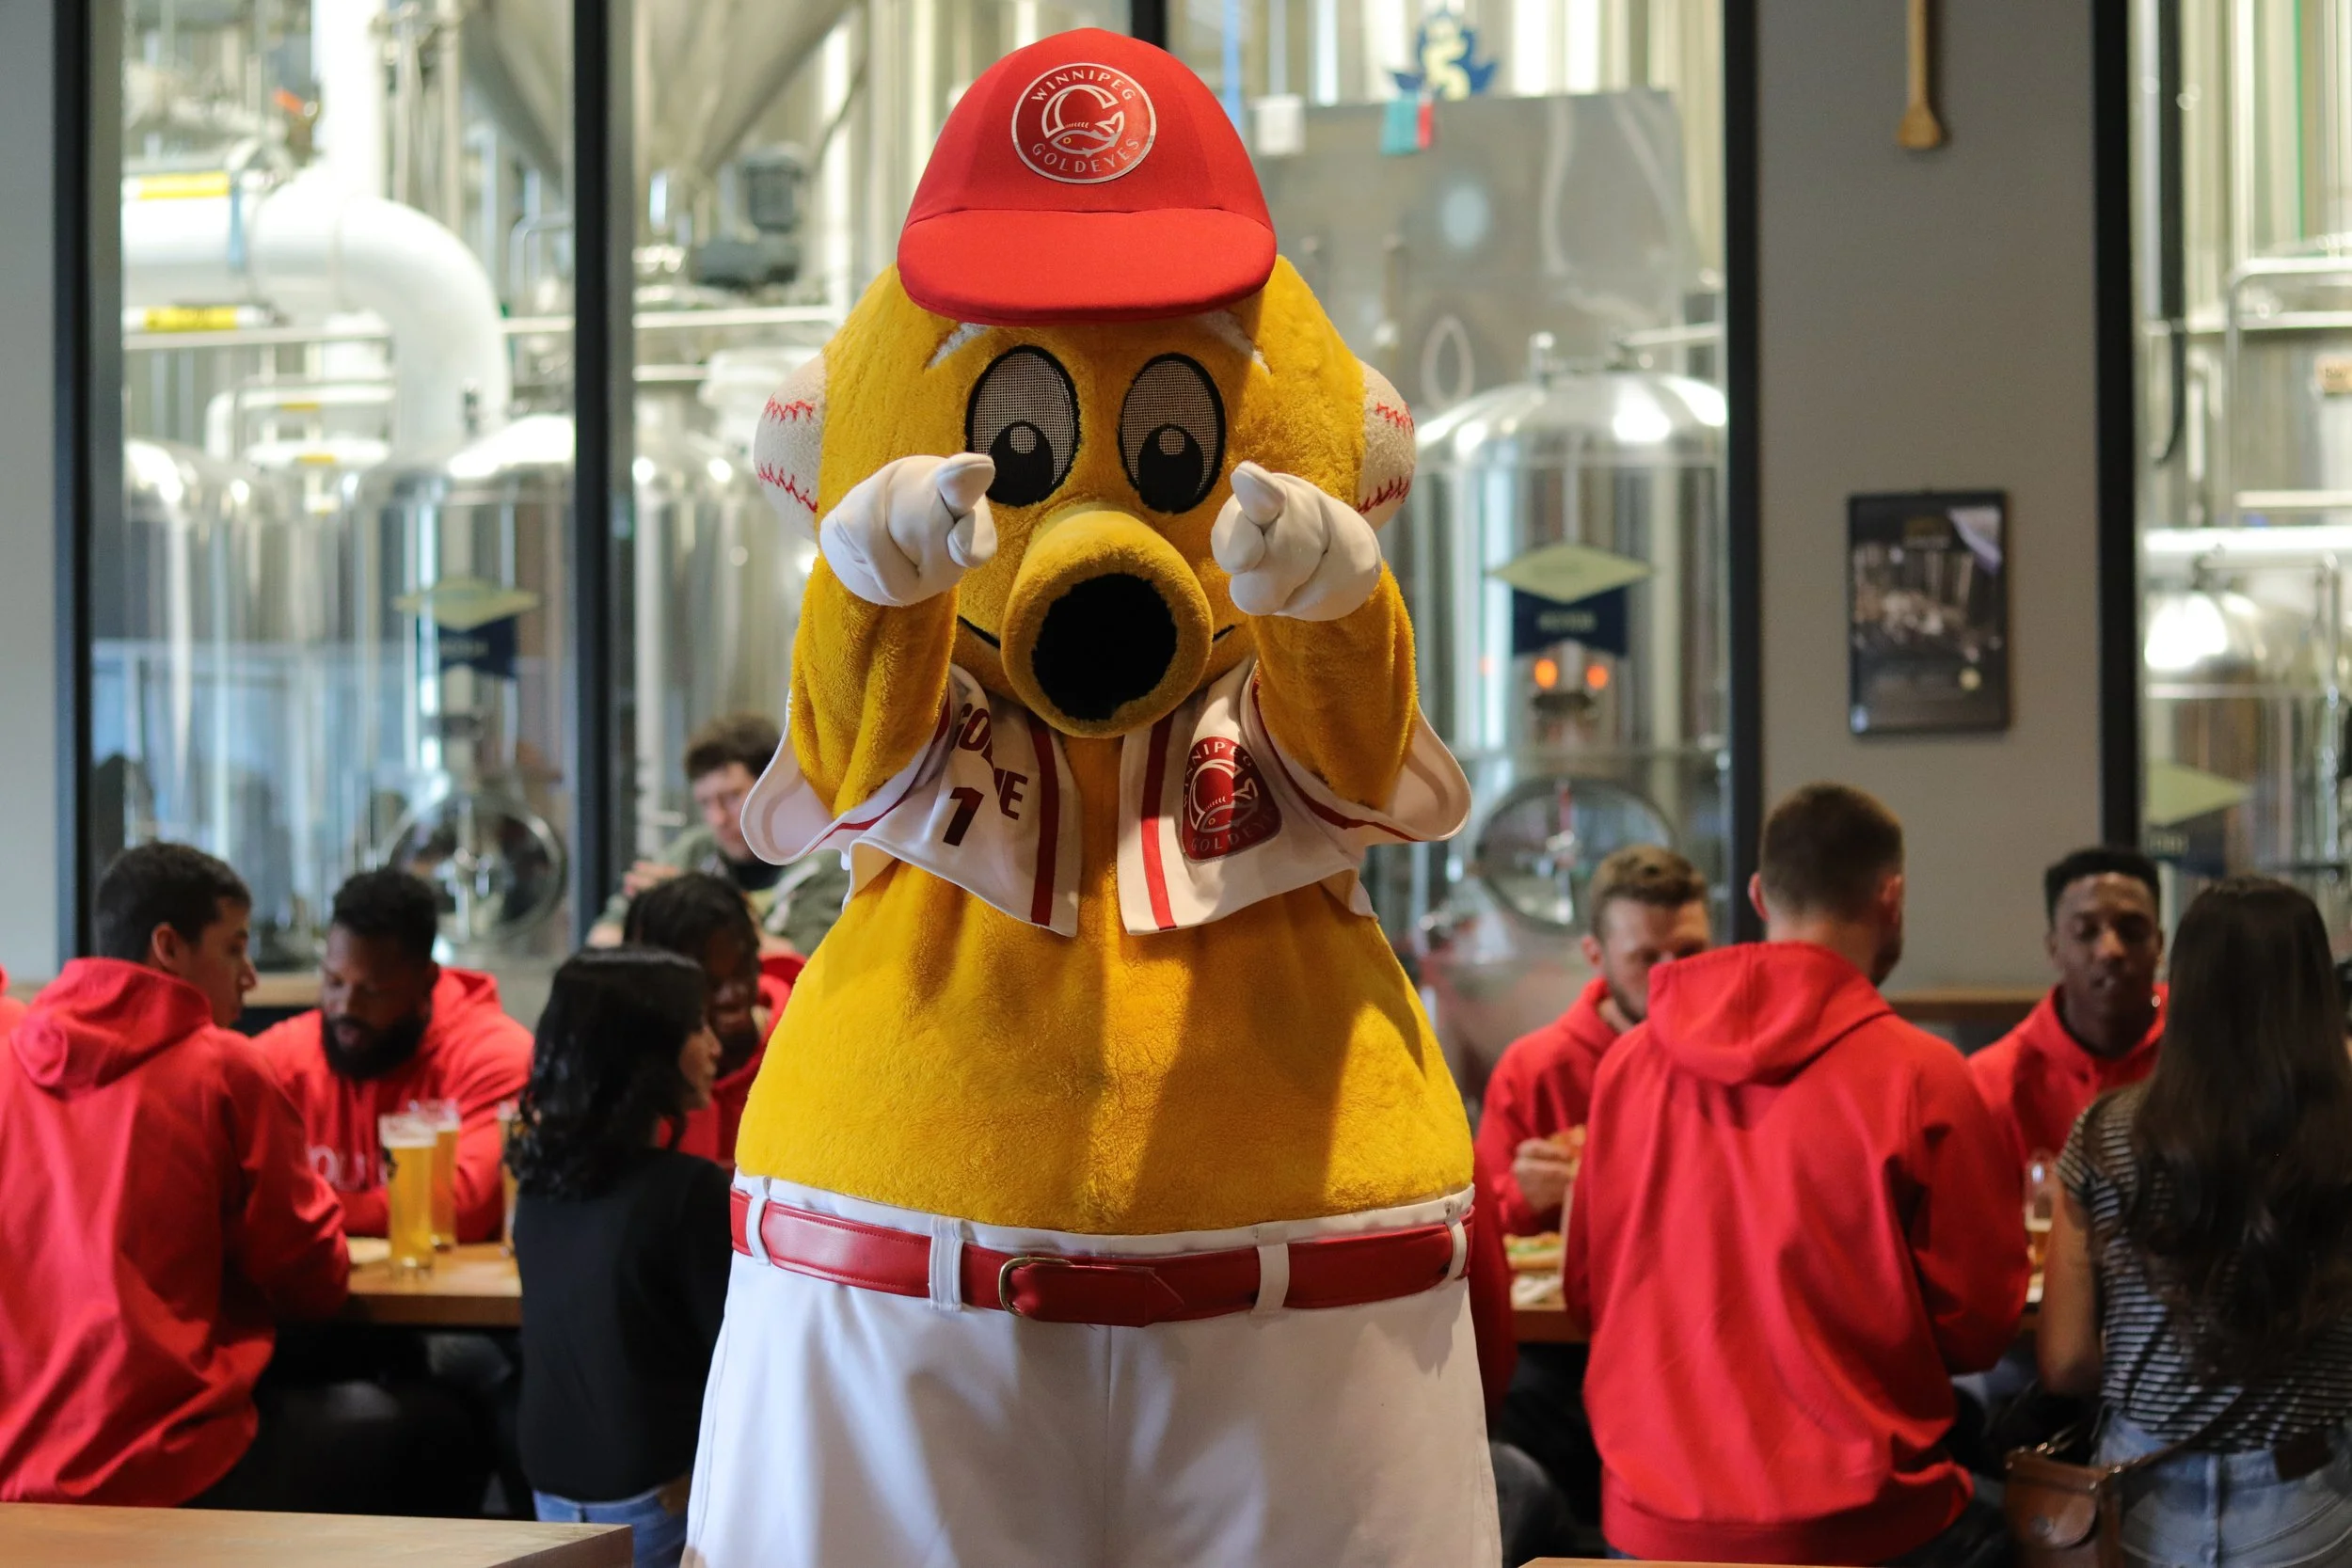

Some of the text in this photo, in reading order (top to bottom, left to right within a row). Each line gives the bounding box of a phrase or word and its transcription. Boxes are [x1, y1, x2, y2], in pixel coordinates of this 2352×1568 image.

[1031, 70, 1136, 102] WINNIPEG
[1032, 138, 1139, 172] GOLDEYES
[943, 787, 984, 847] 1
